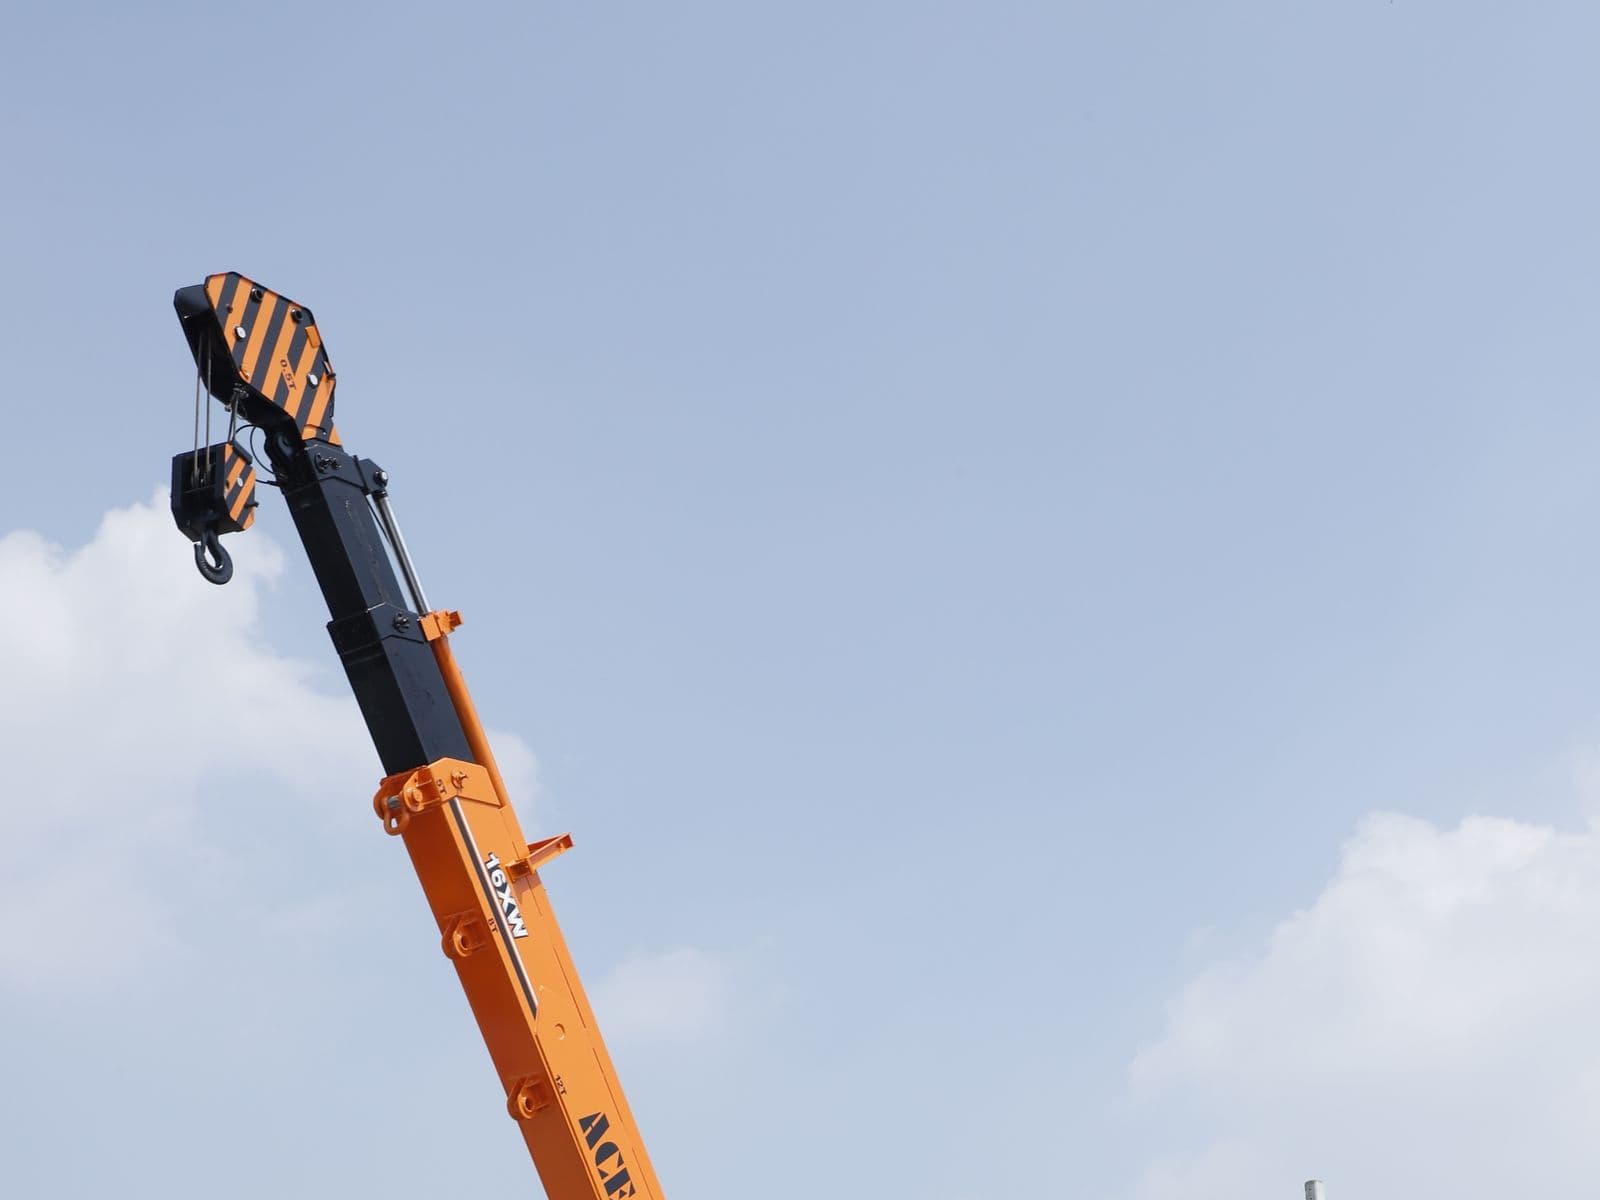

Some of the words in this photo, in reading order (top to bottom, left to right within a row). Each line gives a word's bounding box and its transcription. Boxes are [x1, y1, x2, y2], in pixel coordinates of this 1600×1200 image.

[280, 359, 297, 390] 0.5T
[485, 852, 529, 938] 16XW
[555, 1075, 567, 1096] 12T
